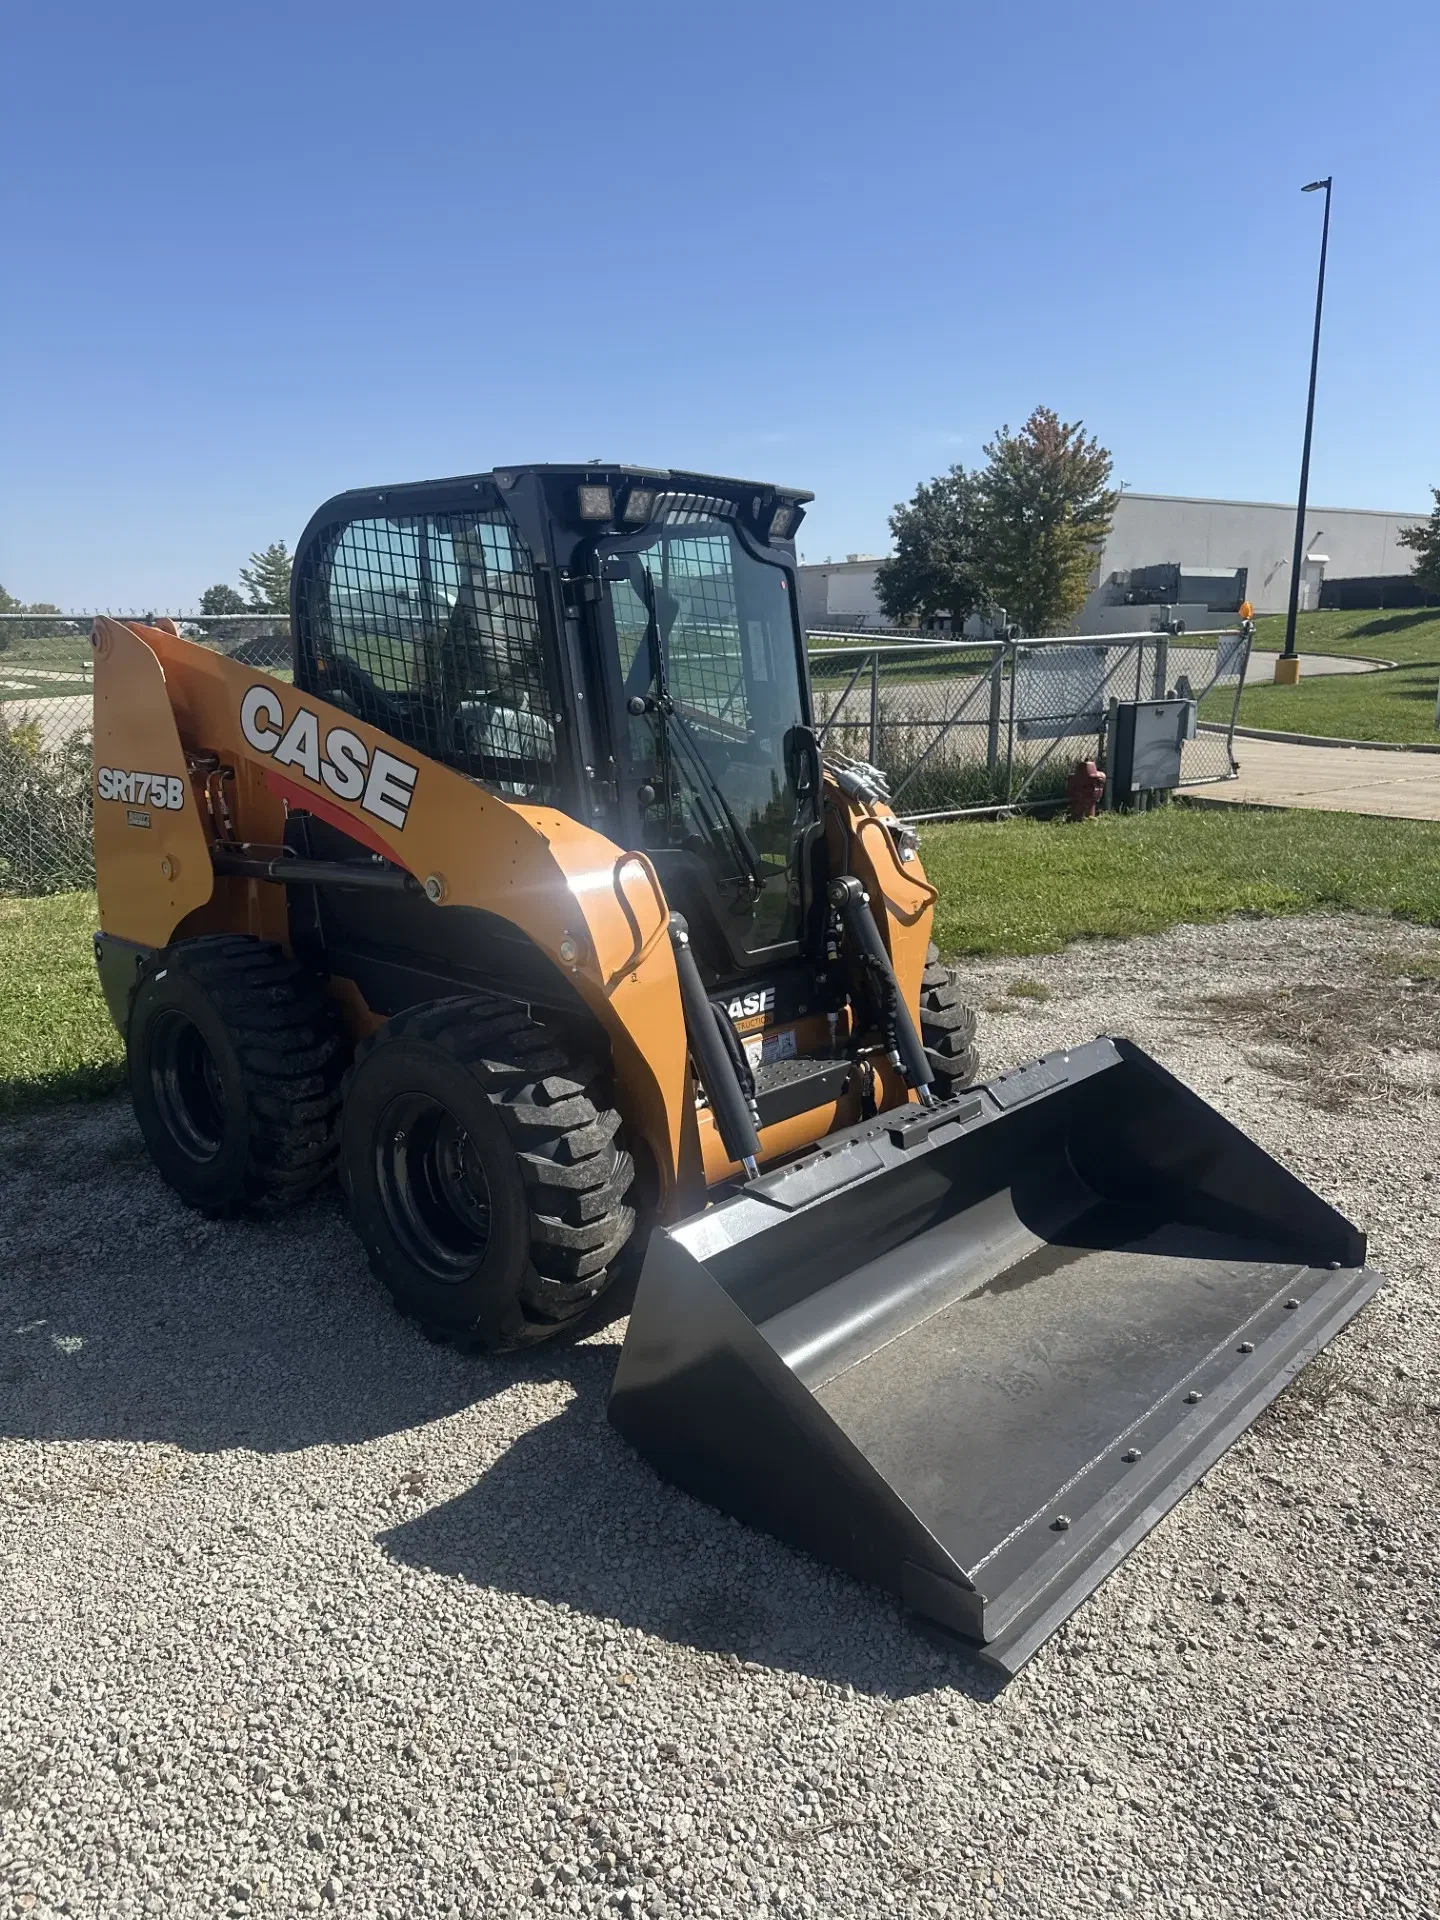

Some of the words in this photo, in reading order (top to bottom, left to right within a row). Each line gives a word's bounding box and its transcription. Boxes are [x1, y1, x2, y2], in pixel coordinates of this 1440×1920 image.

[240, 684, 420, 832] CASE
[98, 766, 184, 811] SR175B
[718, 987, 776, 1018] ASE
[737, 1015, 774, 1031] TRUCTION
